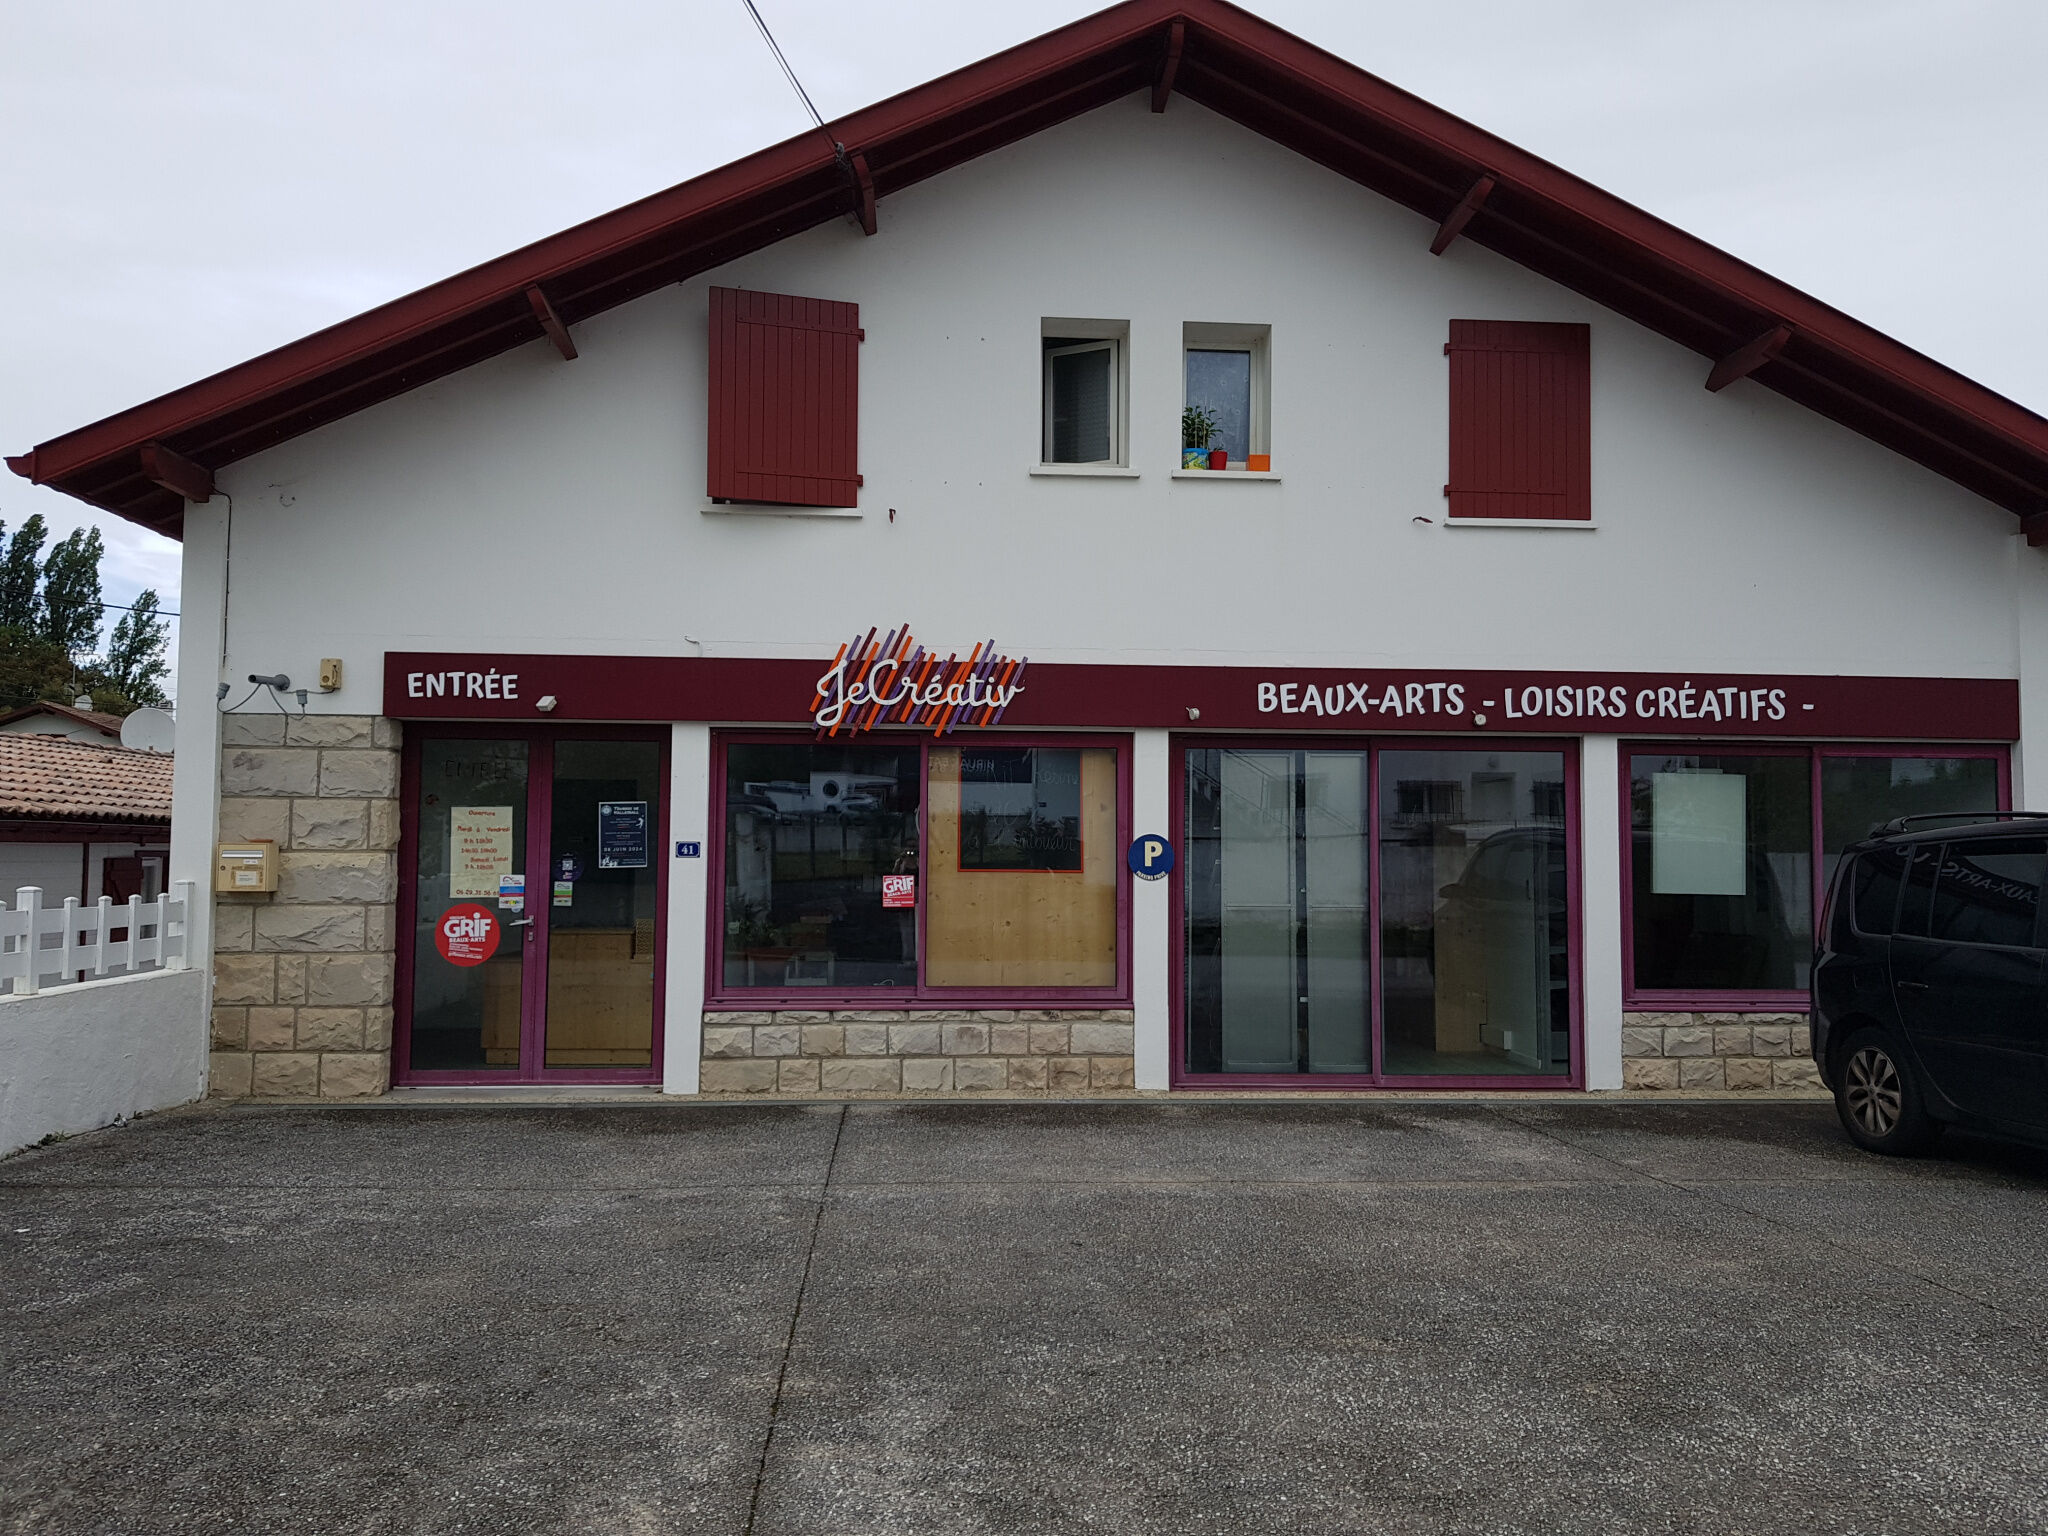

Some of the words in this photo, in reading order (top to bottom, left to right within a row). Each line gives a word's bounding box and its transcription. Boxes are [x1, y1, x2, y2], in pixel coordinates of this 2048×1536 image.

[408, 668, 518, 700] ENTRÉE
[815, 658, 1026, 727] JeCréativ
[1257, 682, 1465, 717] BEAUX-ARTS
[1504, 685, 1627, 718] LOISIRS
[1635, 681, 1786, 721] CRÉATIFS
[681, 844, 694, 854] 41
[1144, 841, 1163, 867] P
